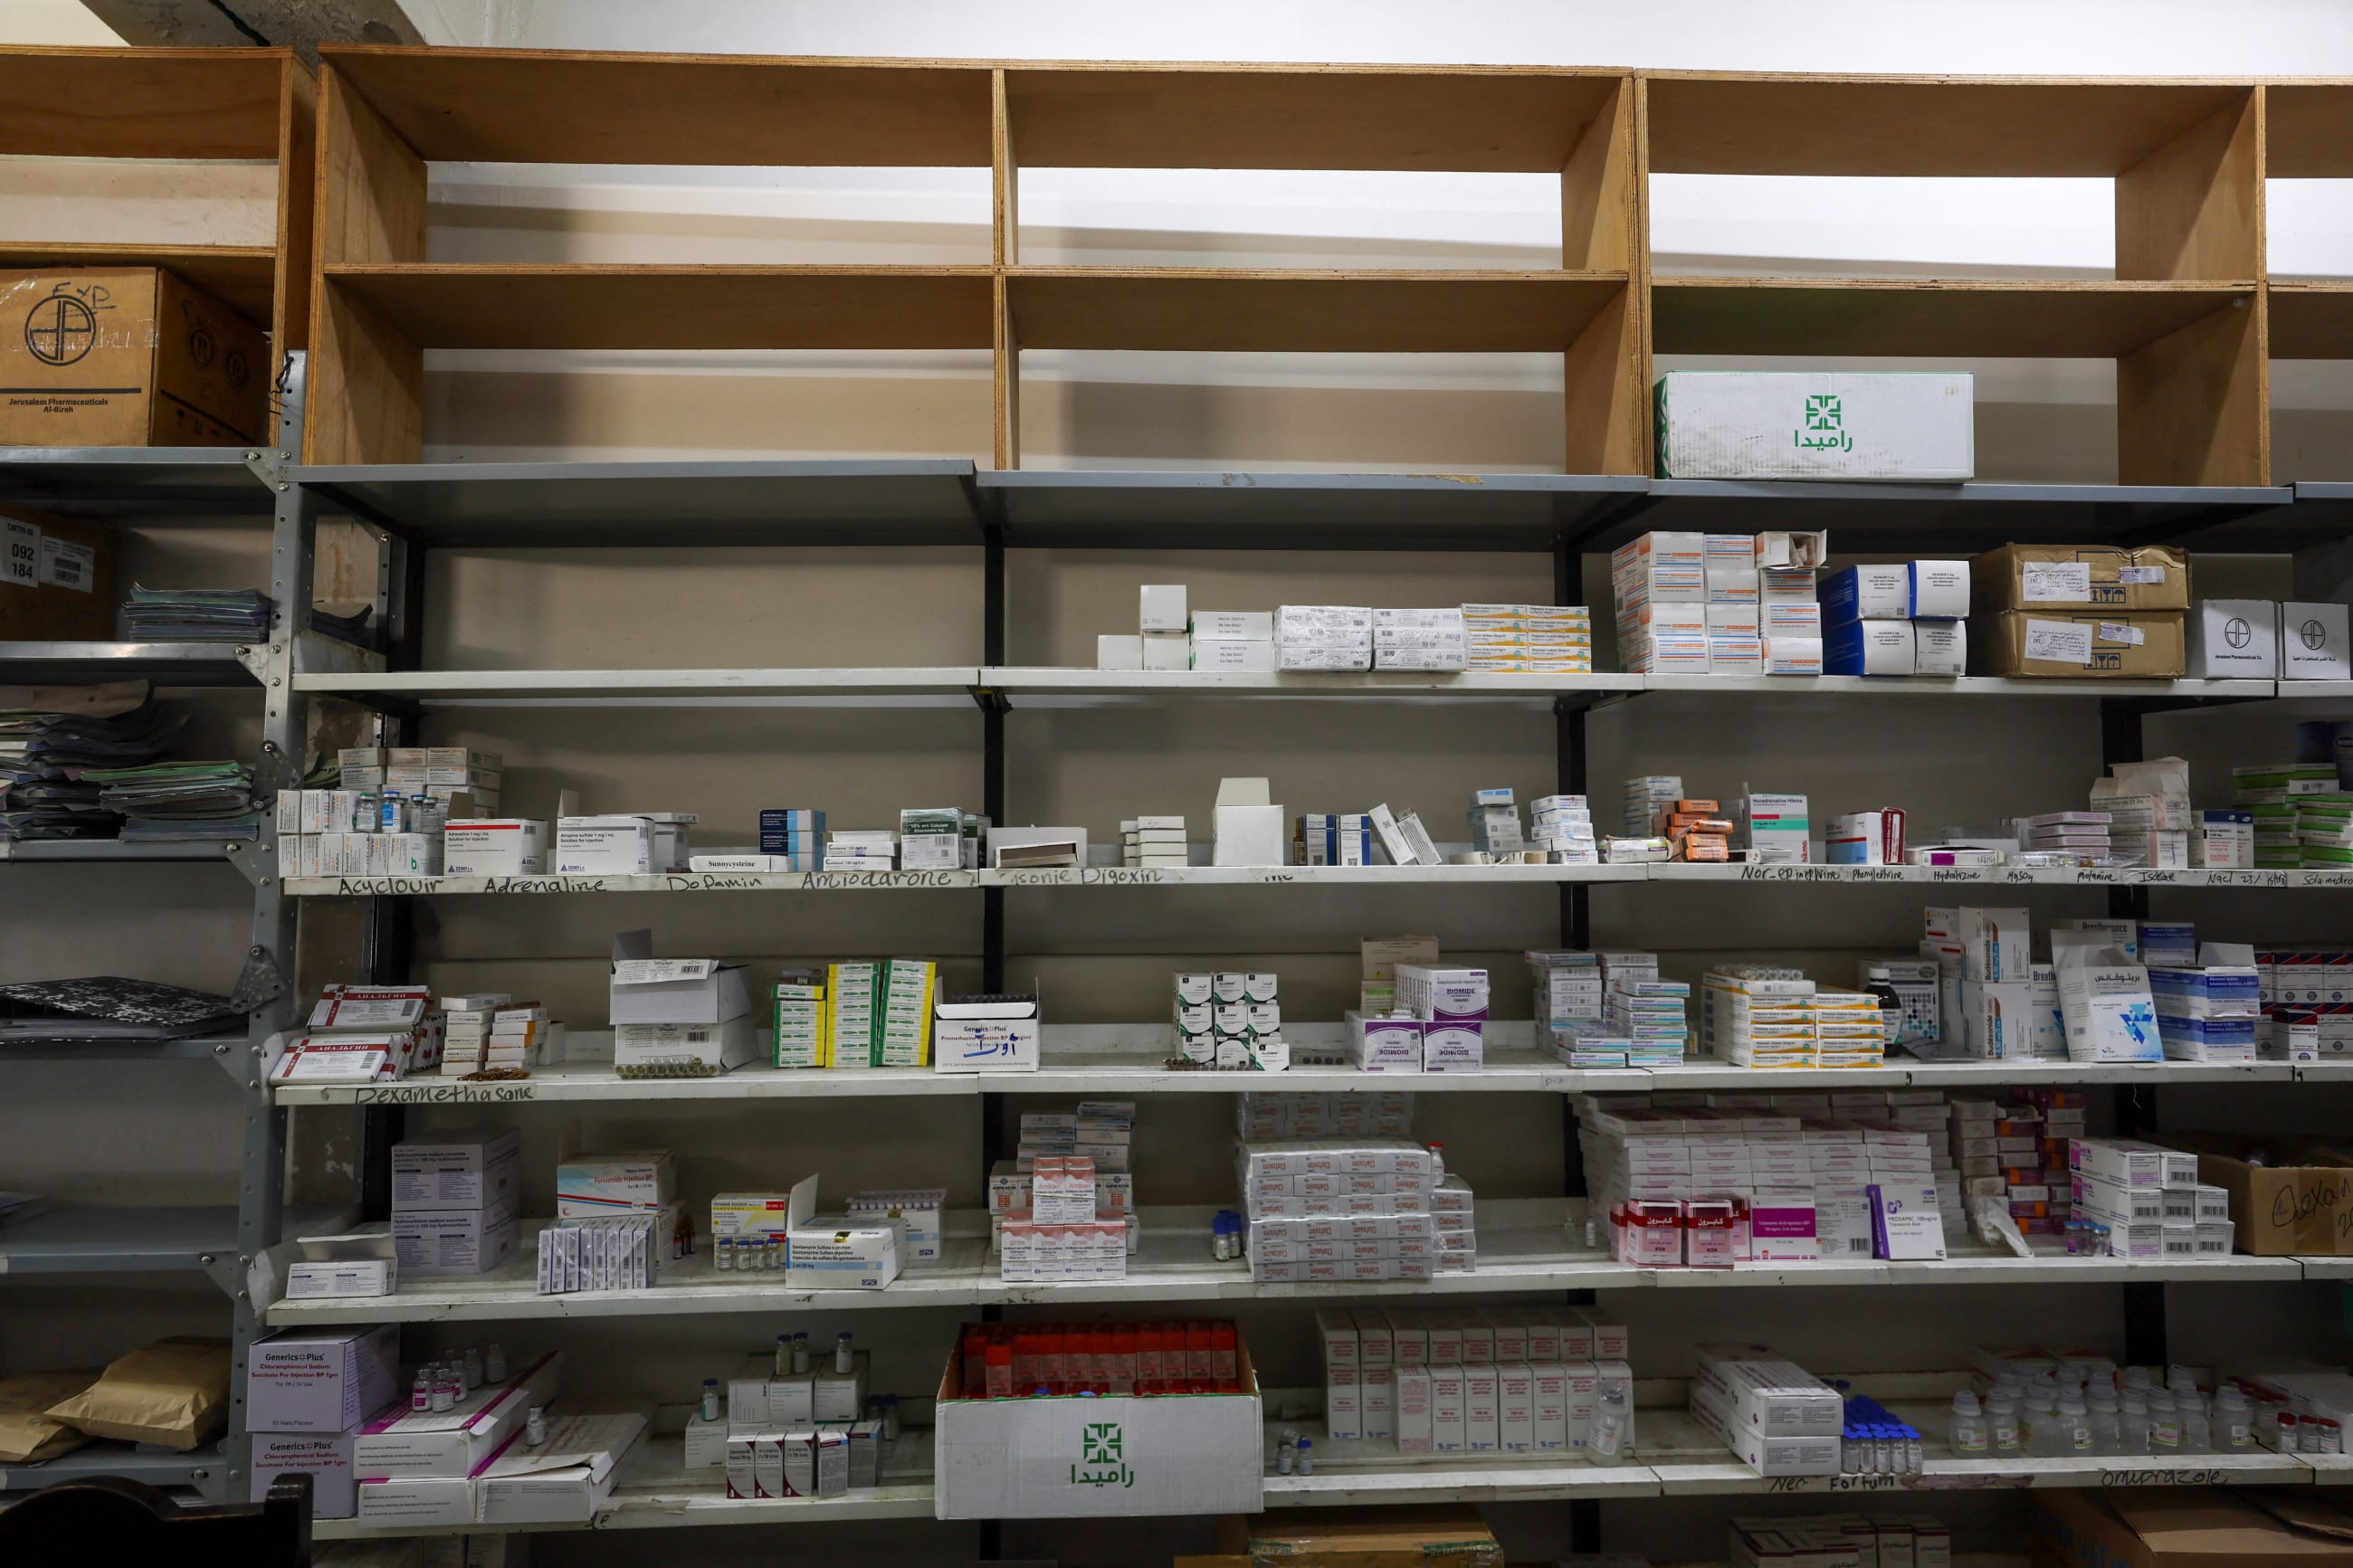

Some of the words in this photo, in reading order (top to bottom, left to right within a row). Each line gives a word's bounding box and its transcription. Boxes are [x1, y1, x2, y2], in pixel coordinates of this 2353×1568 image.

[48, 398, 109, 406] Pharmaceuticals
[1795, 430, 1853, 451] راميدا
[12, 543, 35, 561] 092
[12, 563, 33, 579] 184
[708, 860, 756, 868] Sunnycysteine
[484, 876, 607, 894] Adrenaline
[802, 871, 951, 889] Amiodarone
[1081, 869, 1163, 885] Digoxin
[355, 1086, 534, 1105] Dexamethasone
[265, 1353, 299, 1362] Generics
[306, 1353, 323, 1361] Plus
[270, 1442, 305, 1451] Generics
[313, 1441, 331, 1449] Plus
[1071, 1463, 1135, 1488] راميدا
[1830, 1475, 1894, 1492] Fortum
